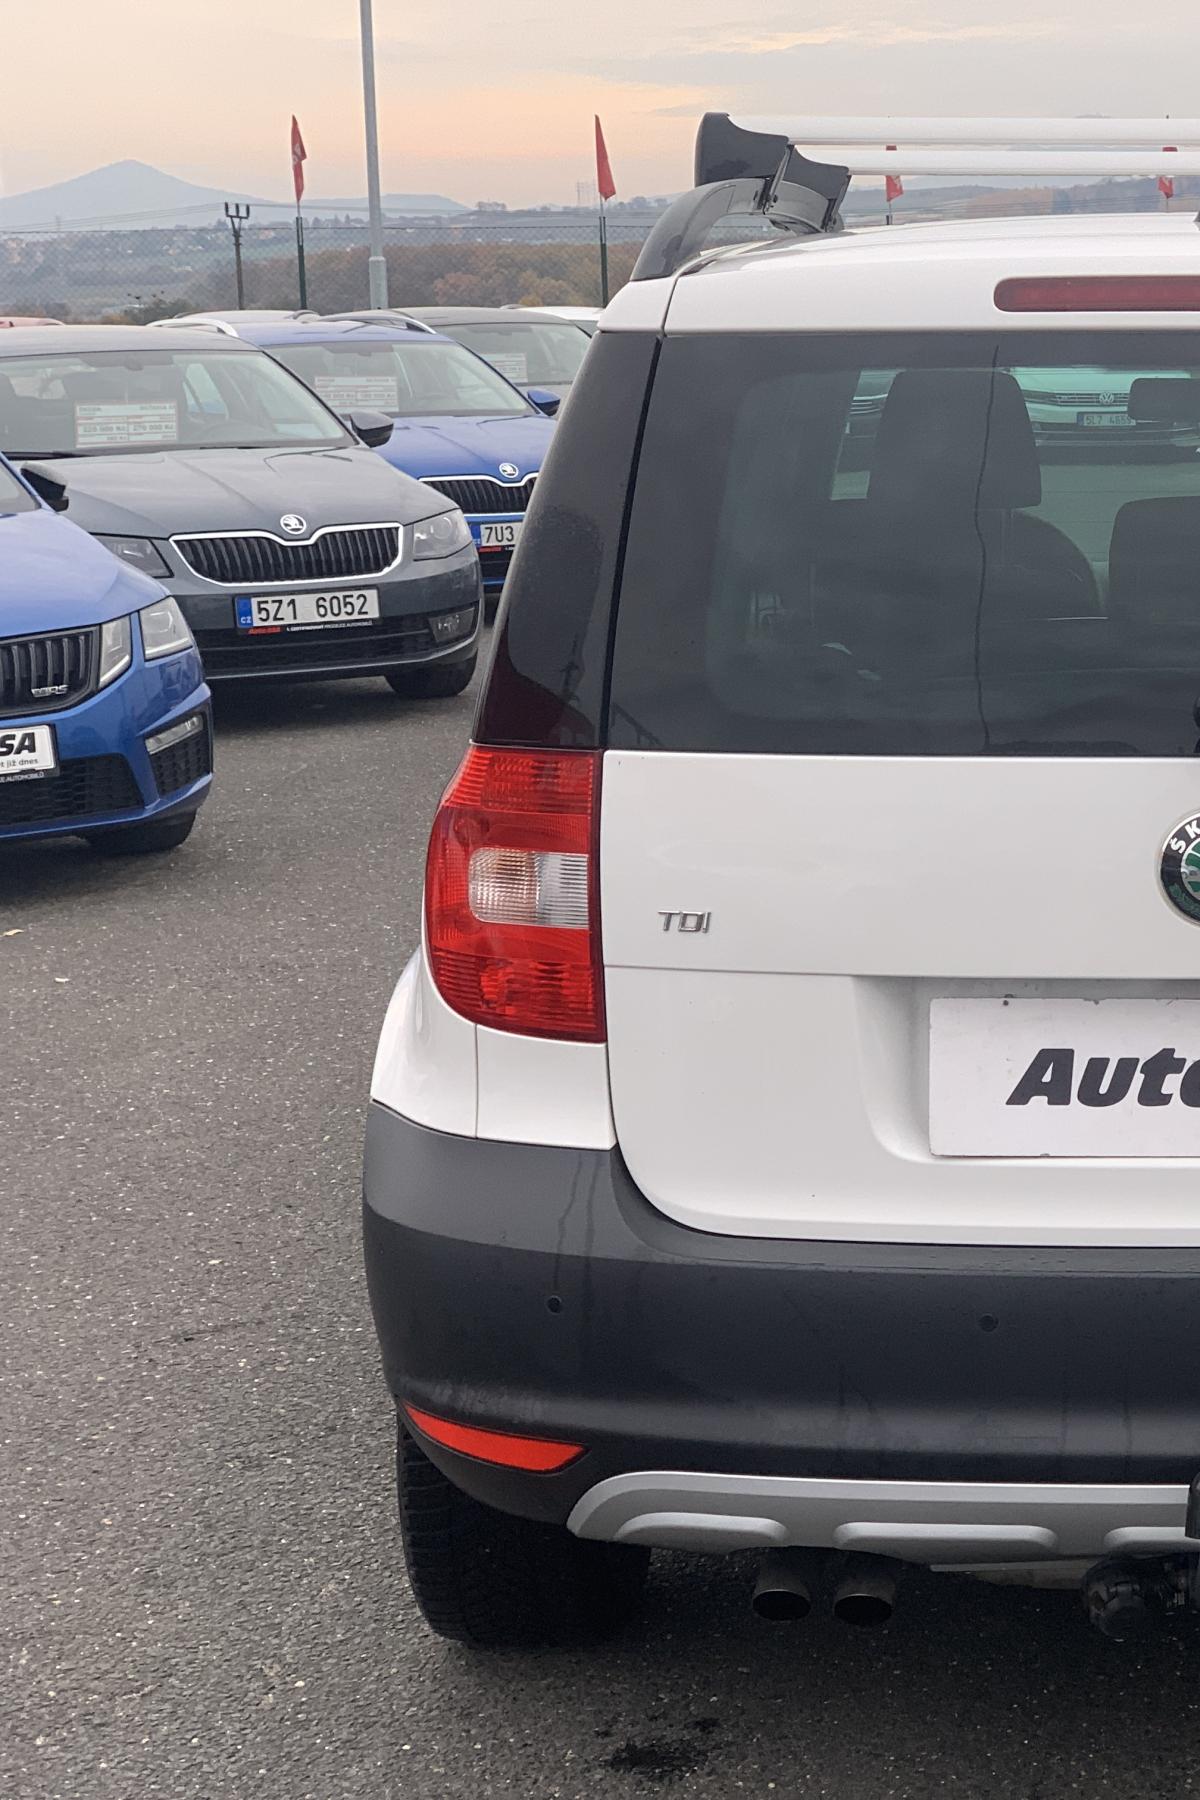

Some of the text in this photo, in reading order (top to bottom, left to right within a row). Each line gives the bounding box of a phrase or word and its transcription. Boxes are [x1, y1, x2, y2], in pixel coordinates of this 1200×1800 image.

[484, 526, 514, 543] 7U3
[257, 593, 369, 622] 5Z1 6052
[240, 616, 251, 624] CZ
[18, 758, 39, 766] dnes
[657, 910, 711, 934] TDI
